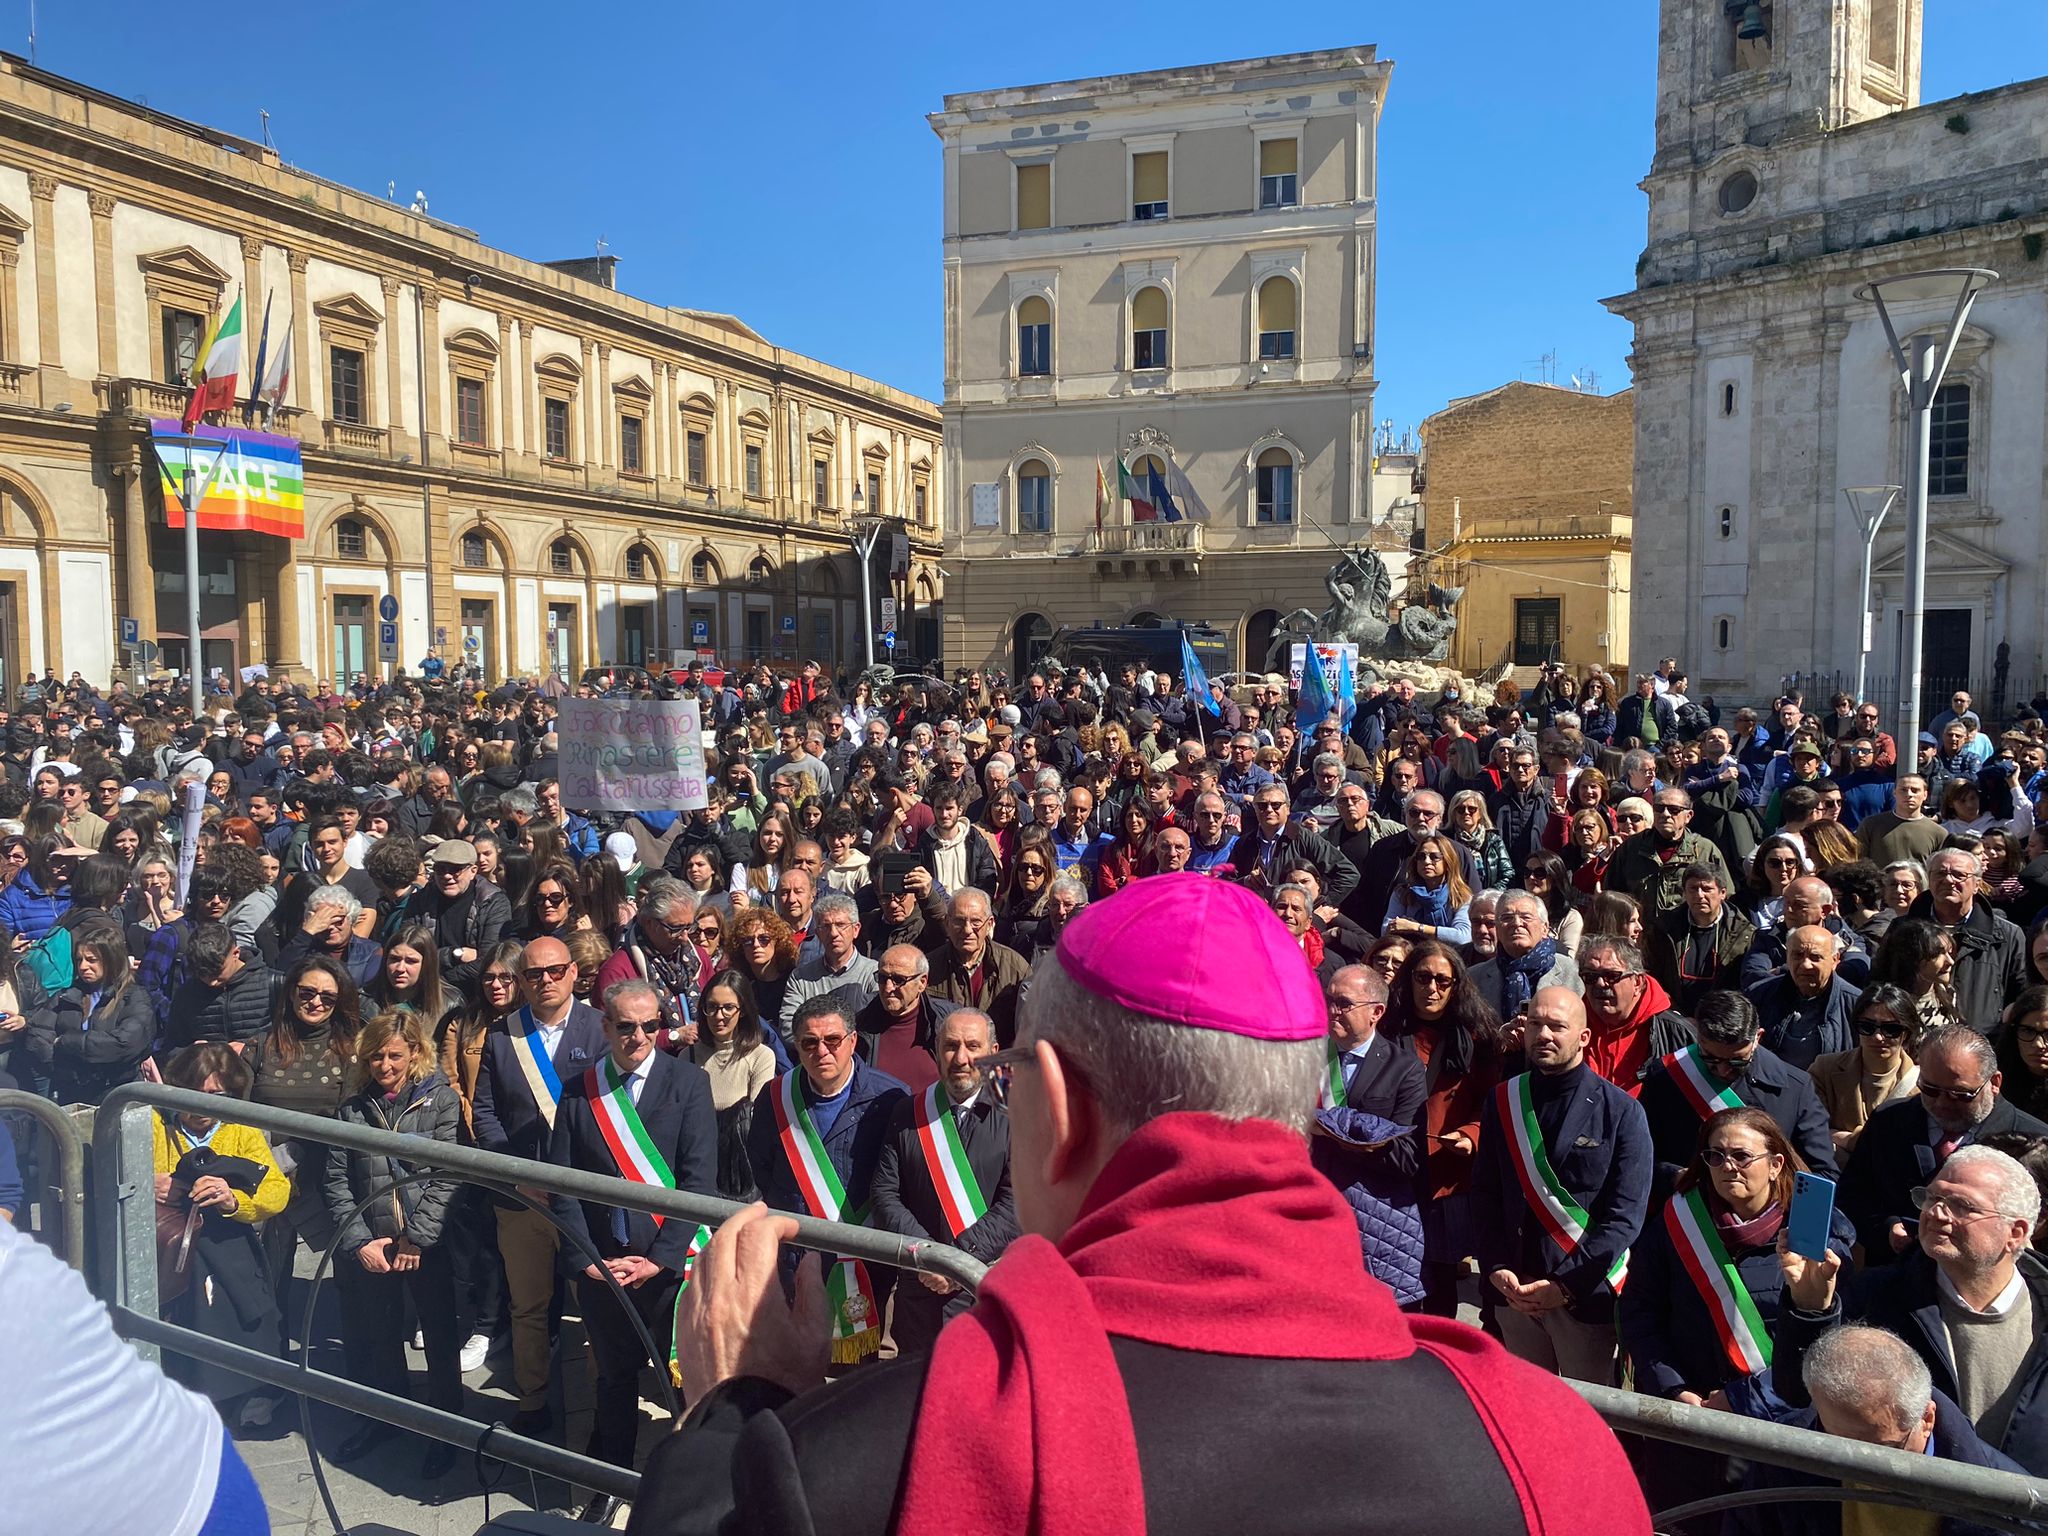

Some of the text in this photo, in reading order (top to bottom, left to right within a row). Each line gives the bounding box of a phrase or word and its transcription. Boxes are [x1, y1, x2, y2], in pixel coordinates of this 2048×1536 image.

[190, 454, 281, 502] PACE
[124, 621, 135, 640] P
[695, 622, 705, 635] P
[783, 617, 793, 629] P
[383, 626, 393, 642] P
[567, 709, 694, 736] Facciamo
